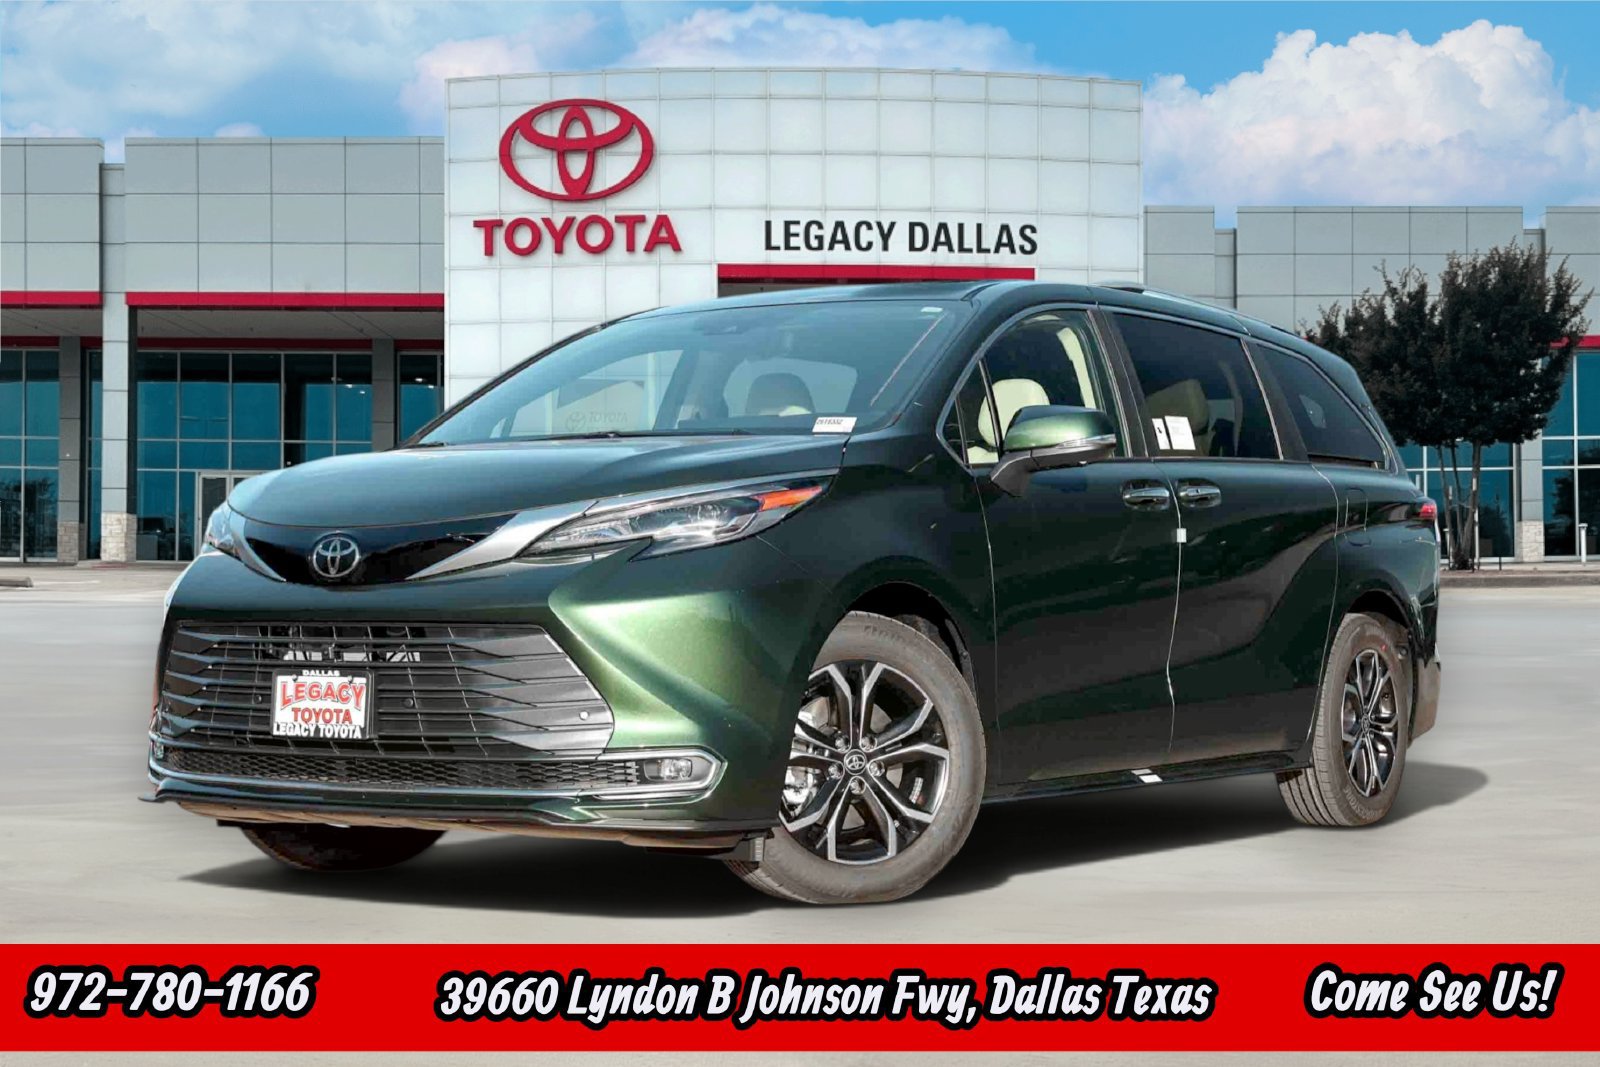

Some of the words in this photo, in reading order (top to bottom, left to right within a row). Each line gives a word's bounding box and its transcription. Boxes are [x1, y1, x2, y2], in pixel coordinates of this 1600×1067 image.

[474, 213, 682, 256] TOYOTA
[764, 219, 896, 253] LEGACY
[908, 221, 1038, 255] DALLAS
[302, 669, 340, 677] DALLAS
[280, 681, 366, 711] LEGACY
[291, 707, 353, 725] TOYOTA
[272, 721, 317, 738] LEGACY
[318, 723, 362, 739] TOYOTA
